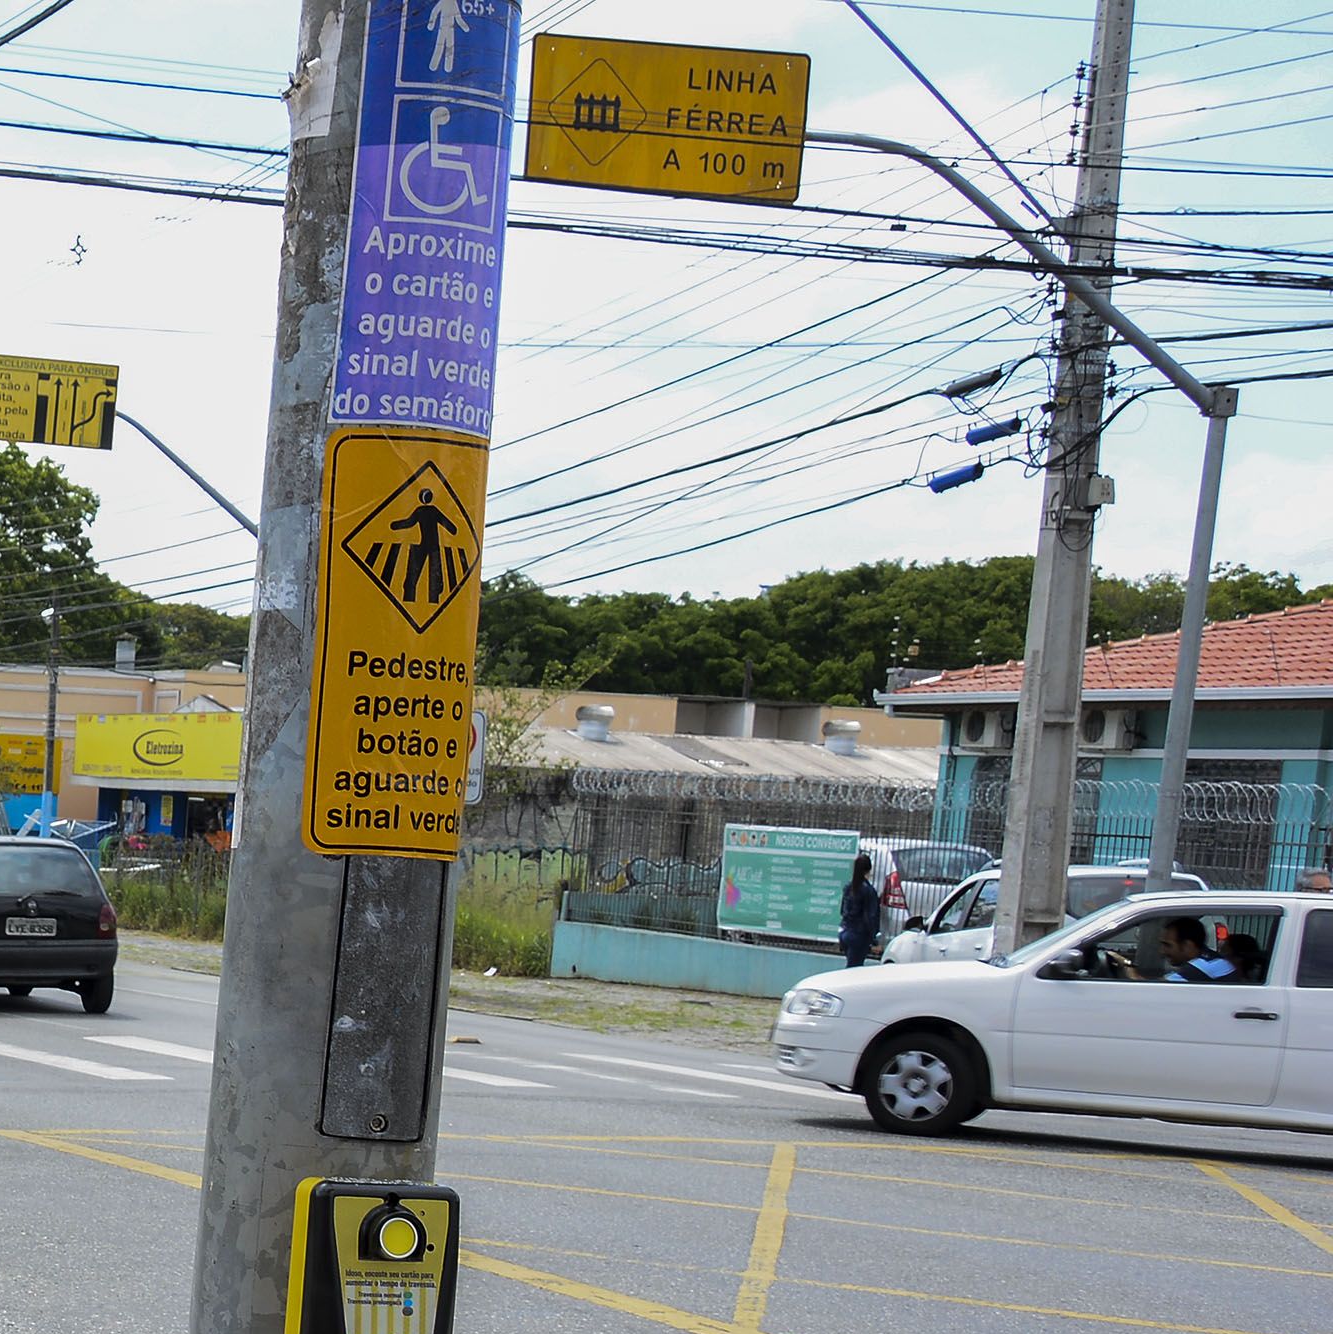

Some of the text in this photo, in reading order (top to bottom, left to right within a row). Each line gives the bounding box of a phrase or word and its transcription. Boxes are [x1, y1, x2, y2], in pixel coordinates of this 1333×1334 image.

[687, 68, 777, 95] LINHA
[666, 104, 788, 137] FÉRREA
[663, 149, 784, 178] A 100 m
[363, 226, 496, 267] Aproxime
[365, 272, 493, 308] o cartão e
[358, 312, 490, 349] aguarde o
[48, 363, 75, 374] PARA
[77, 364, 116, 377] ÔNIBUS
[348, 347, 490, 390] sinal verde
[4, 405, 29, 418] pela
[334, 387, 491, 431] do semáforo
[348, 650, 469, 688] Pedestre,
[353, 694, 463, 723] aperte o
[146, 740, 183, 755] Eletrozina
[357, 728, 458, 759] botão e
[334, 769, 449, 798] aguarde
[326, 803, 400, 829] sinal
[775, 834, 805, 848] NOSSOS
